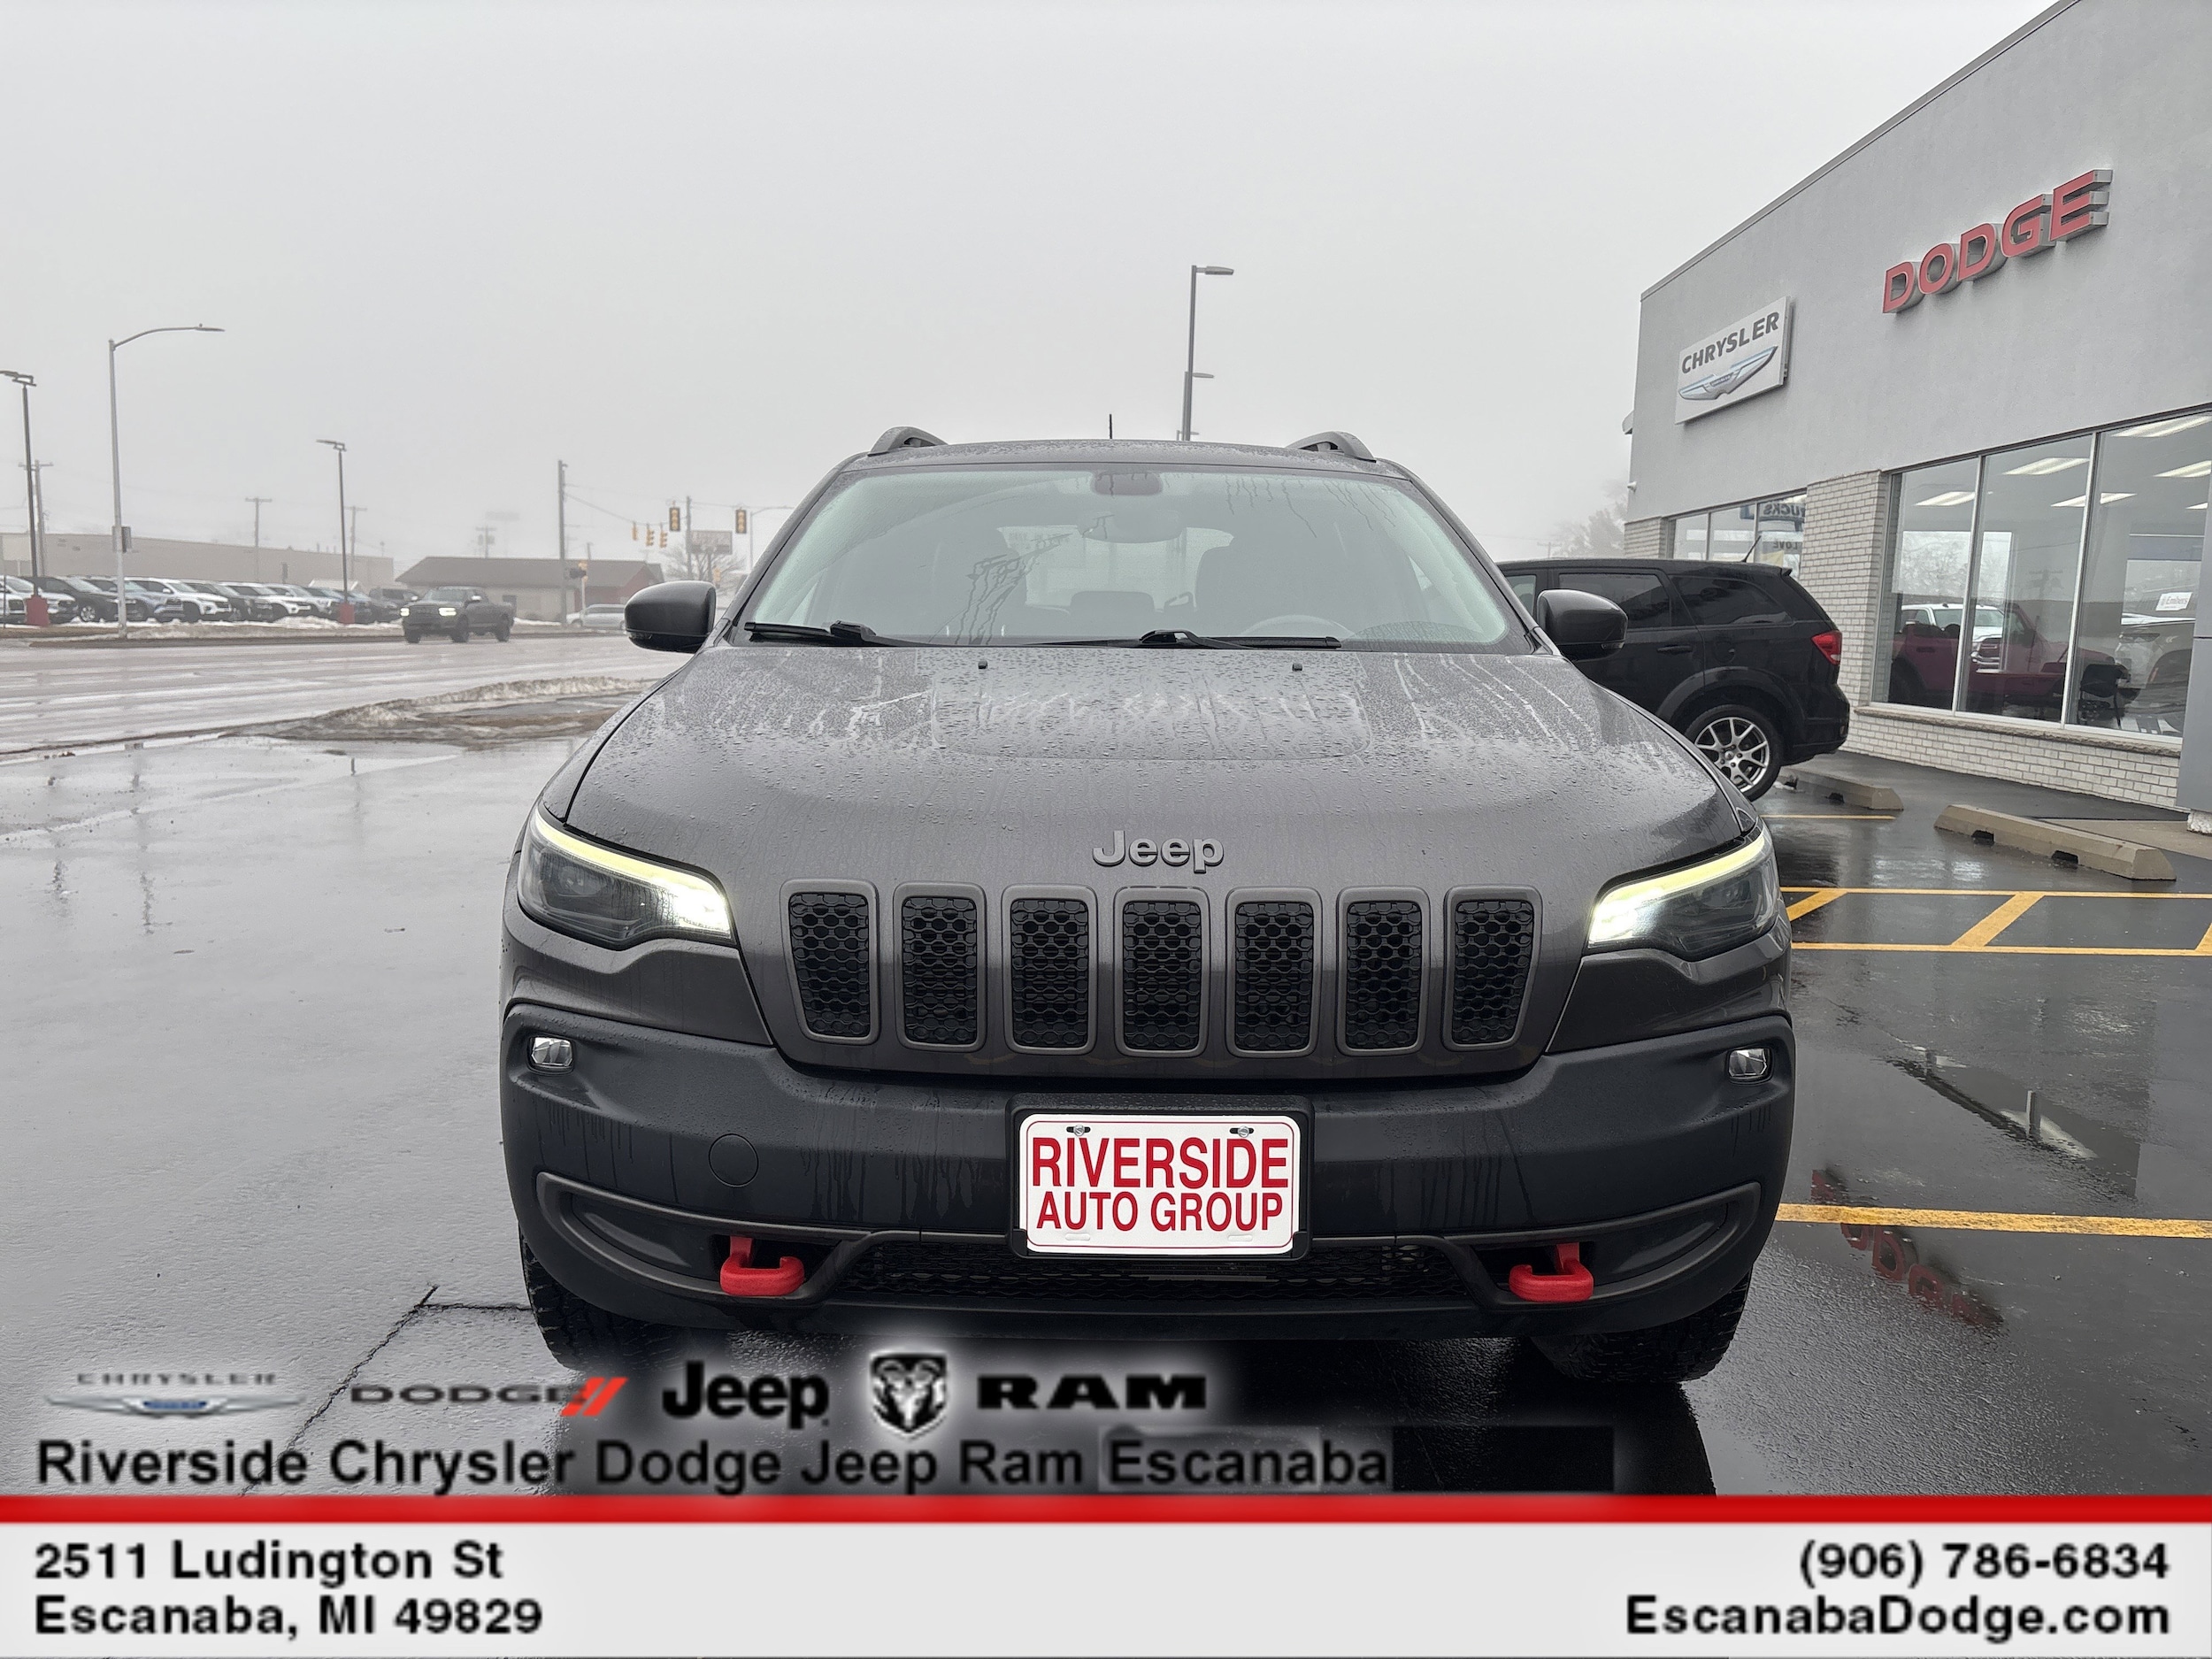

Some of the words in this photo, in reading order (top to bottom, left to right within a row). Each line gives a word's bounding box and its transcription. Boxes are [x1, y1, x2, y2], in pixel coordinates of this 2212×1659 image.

[1882, 169, 2113, 313] DODGE
[1681, 311, 1780, 374] CHRYSLER
[1092, 830, 1225, 874] Jeep
[1032, 1137, 1289, 1189] RIVERSIDE
[1036, 1191, 1139, 1231] AUTO
[1150, 1192, 1283, 1232] GROUP
